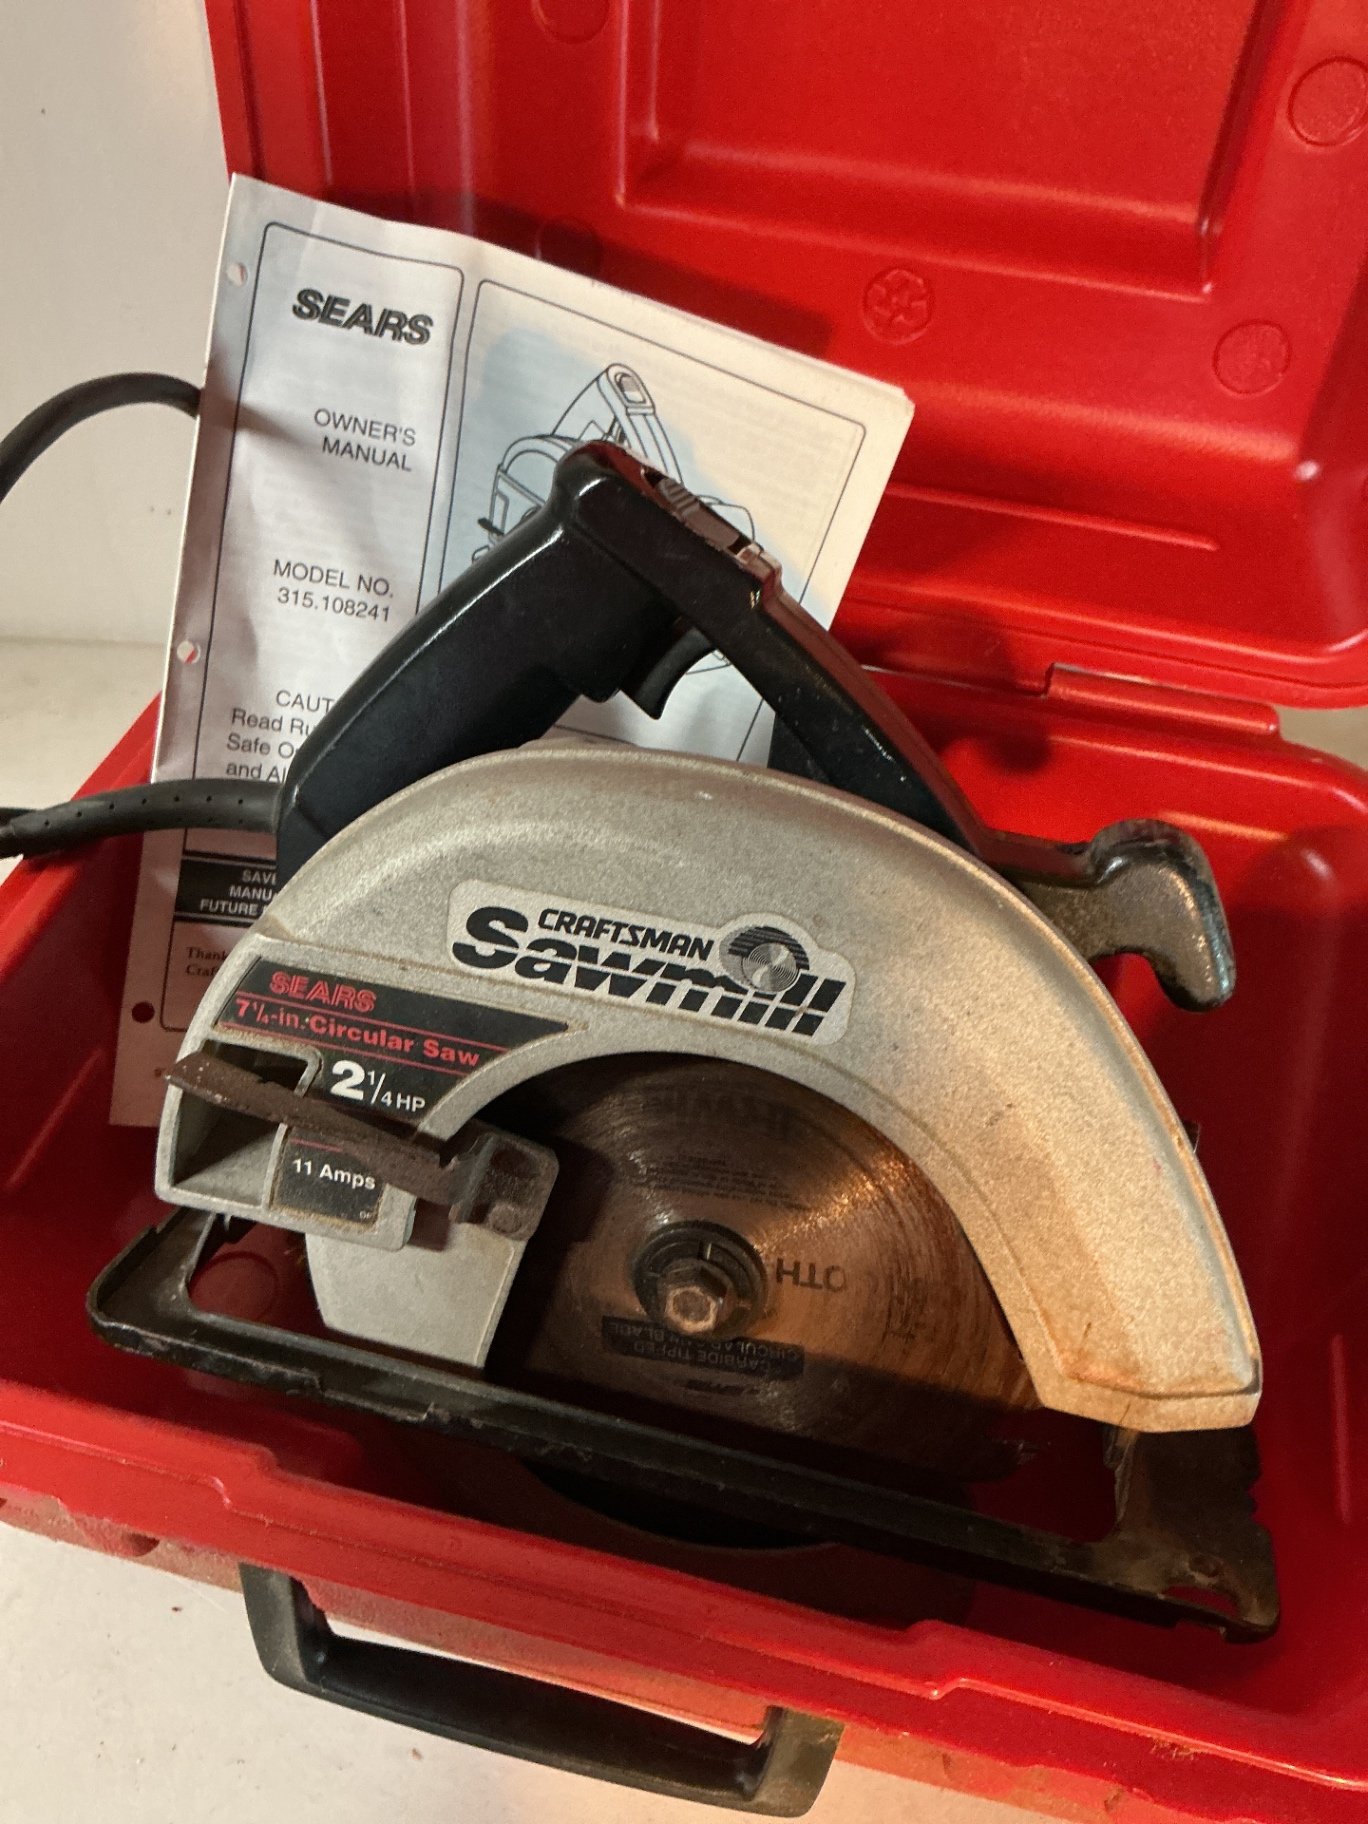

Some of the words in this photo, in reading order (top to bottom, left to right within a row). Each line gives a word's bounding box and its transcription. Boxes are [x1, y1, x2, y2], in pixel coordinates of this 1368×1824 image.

[292, 288, 434, 345] SEARS
[314, 408, 416, 446] OWNER'S
[322, 436, 413, 472] MANUAL
[273, 559, 350, 589] MODEL
[357, 574, 394, 598] NO.
[277, 587, 390, 622] 315.108241
[232, 707, 283, 732] Read
[226, 732, 271, 756] Safe
[226, 762, 262, 779] and
[200, 898, 258, 916] FUTURE
[538, 908, 714, 962] CRAFTSMAN
[452, 905, 847, 1038] Sawmill
[269, 971, 377, 1013] SEARS
[309, 1014, 415, 1053] Circular
[422, 1039, 480, 1068] Saw
[396, 1093, 426, 1113] HP
[293, 1158, 312, 1176] 11
[319, 1164, 376, 1190] Amps
